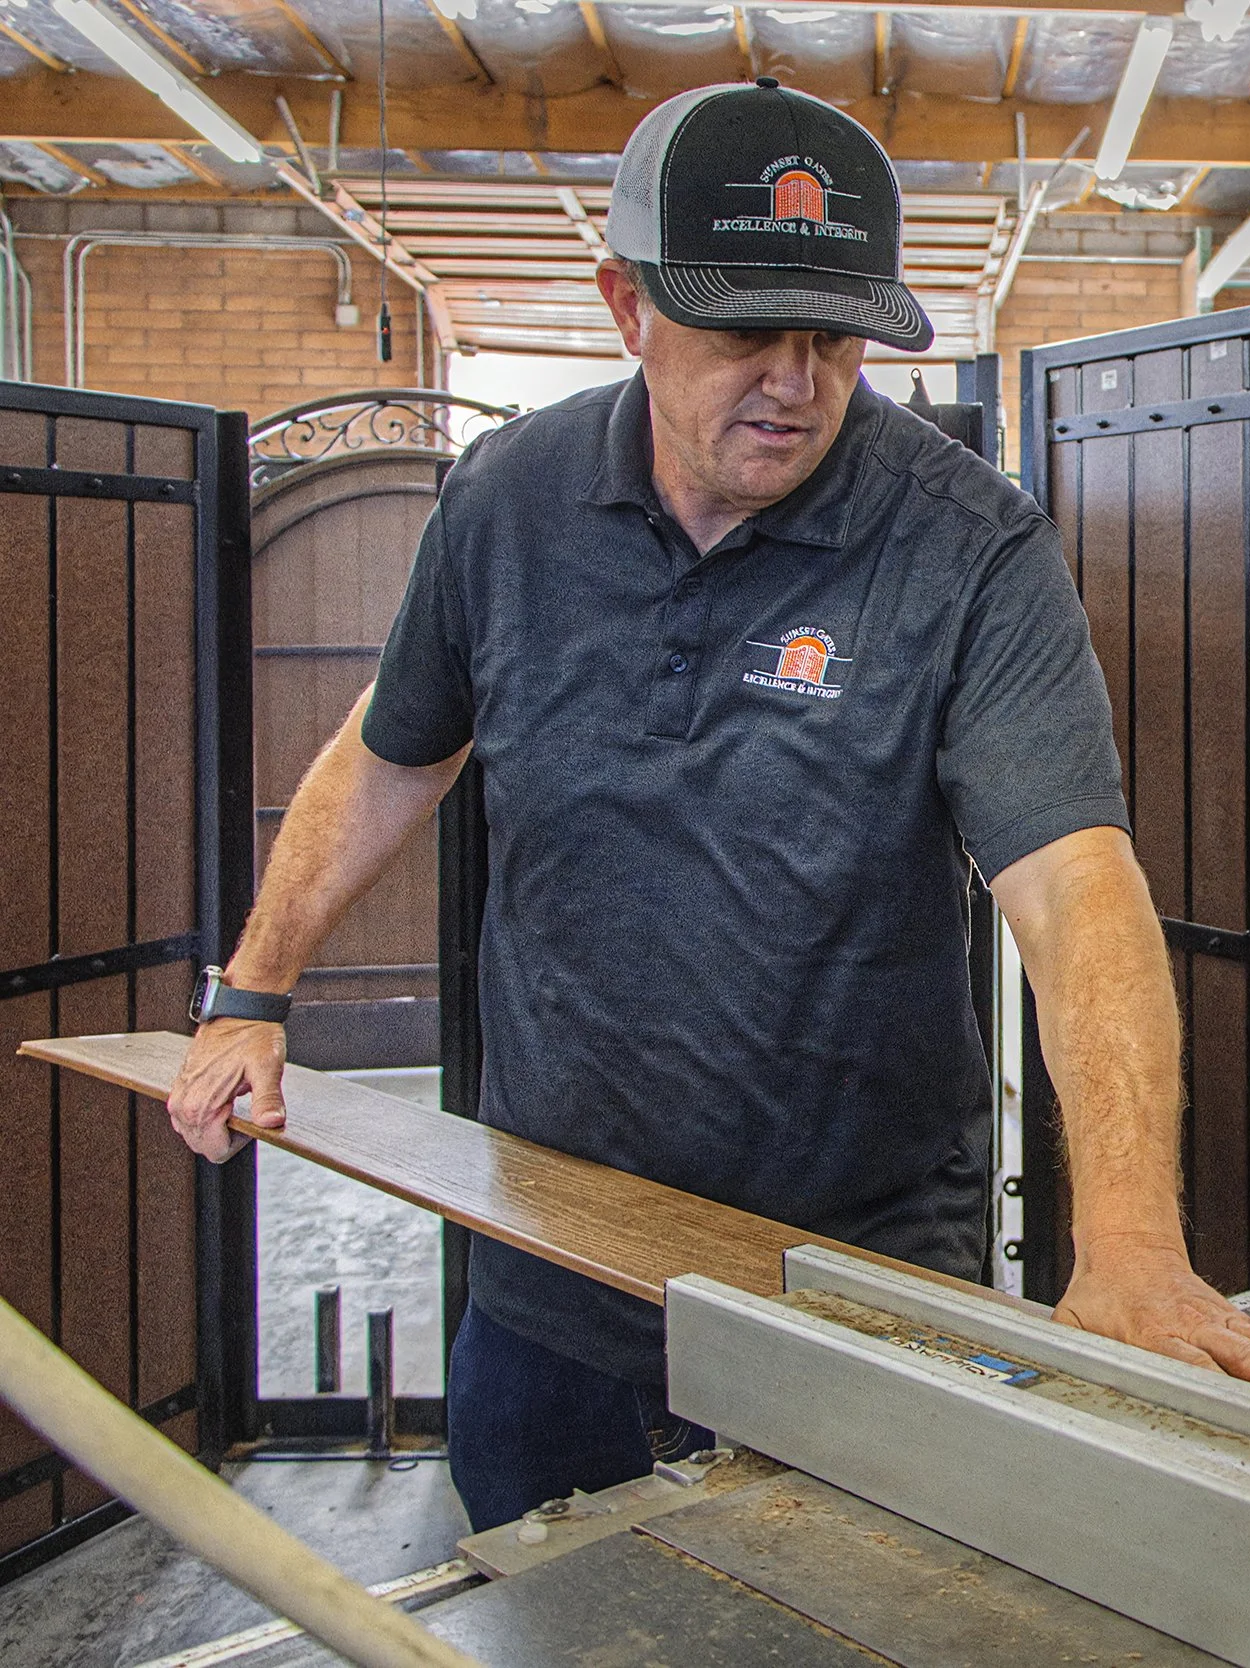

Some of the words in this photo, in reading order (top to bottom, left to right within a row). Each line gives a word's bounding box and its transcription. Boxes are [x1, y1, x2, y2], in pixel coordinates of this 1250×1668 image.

[760, 155, 800, 183] SUNSET
[713, 219, 796, 234] EXCELLENCE
[800, 222, 810, 236] &
